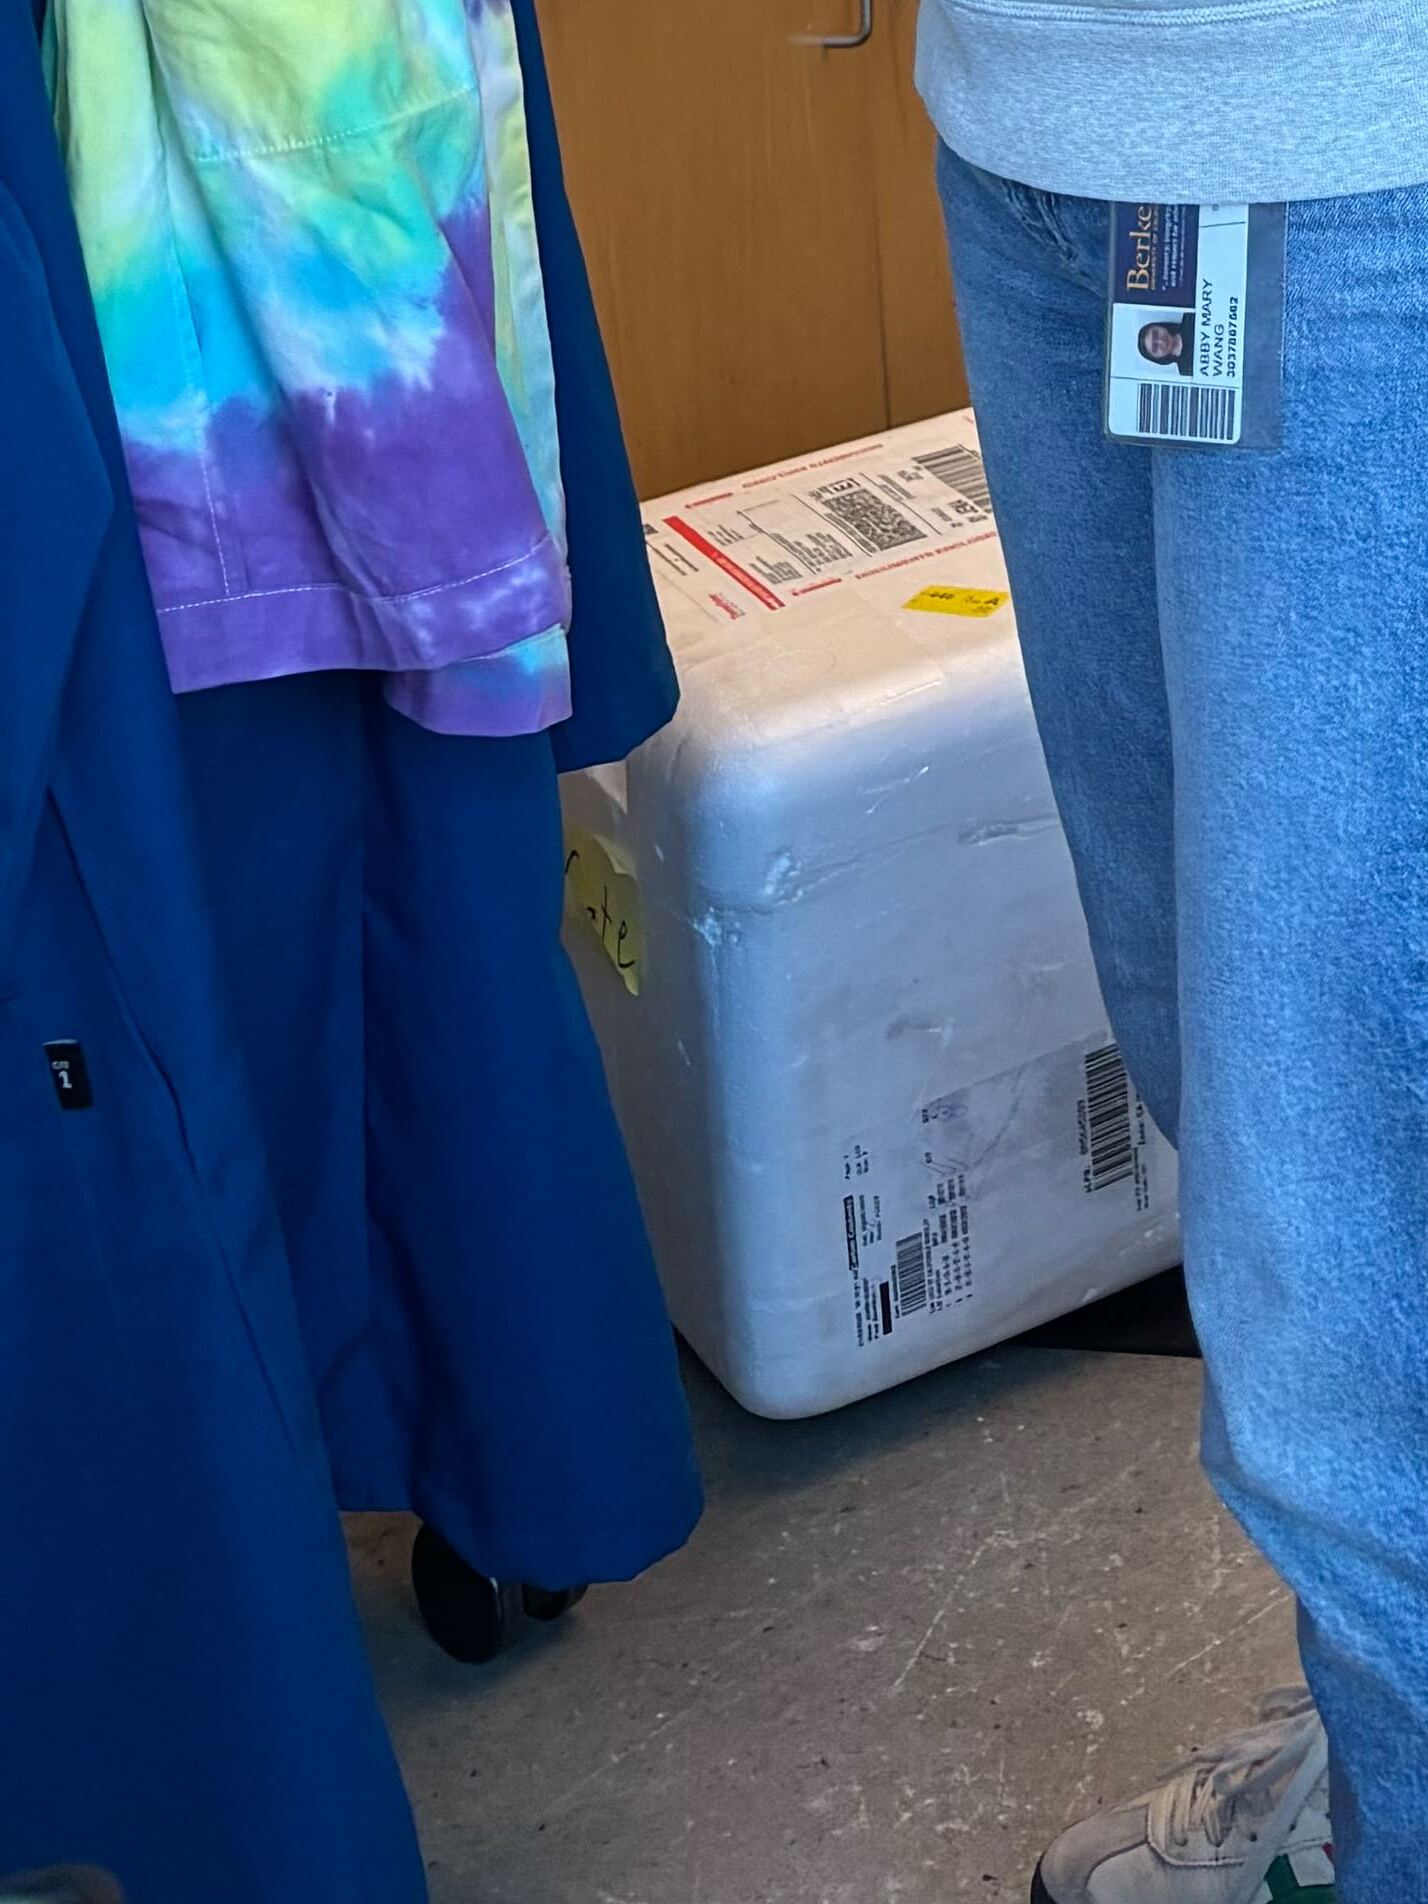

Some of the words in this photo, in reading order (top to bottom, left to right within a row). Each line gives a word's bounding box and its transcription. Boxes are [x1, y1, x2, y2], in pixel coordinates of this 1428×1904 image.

[1126, 205, 1152, 293] Berke
[1201, 278, 1213, 327] MARY
[1199, 331, 1211, 377] ABBY
[1213, 323, 1225, 377] WANG
